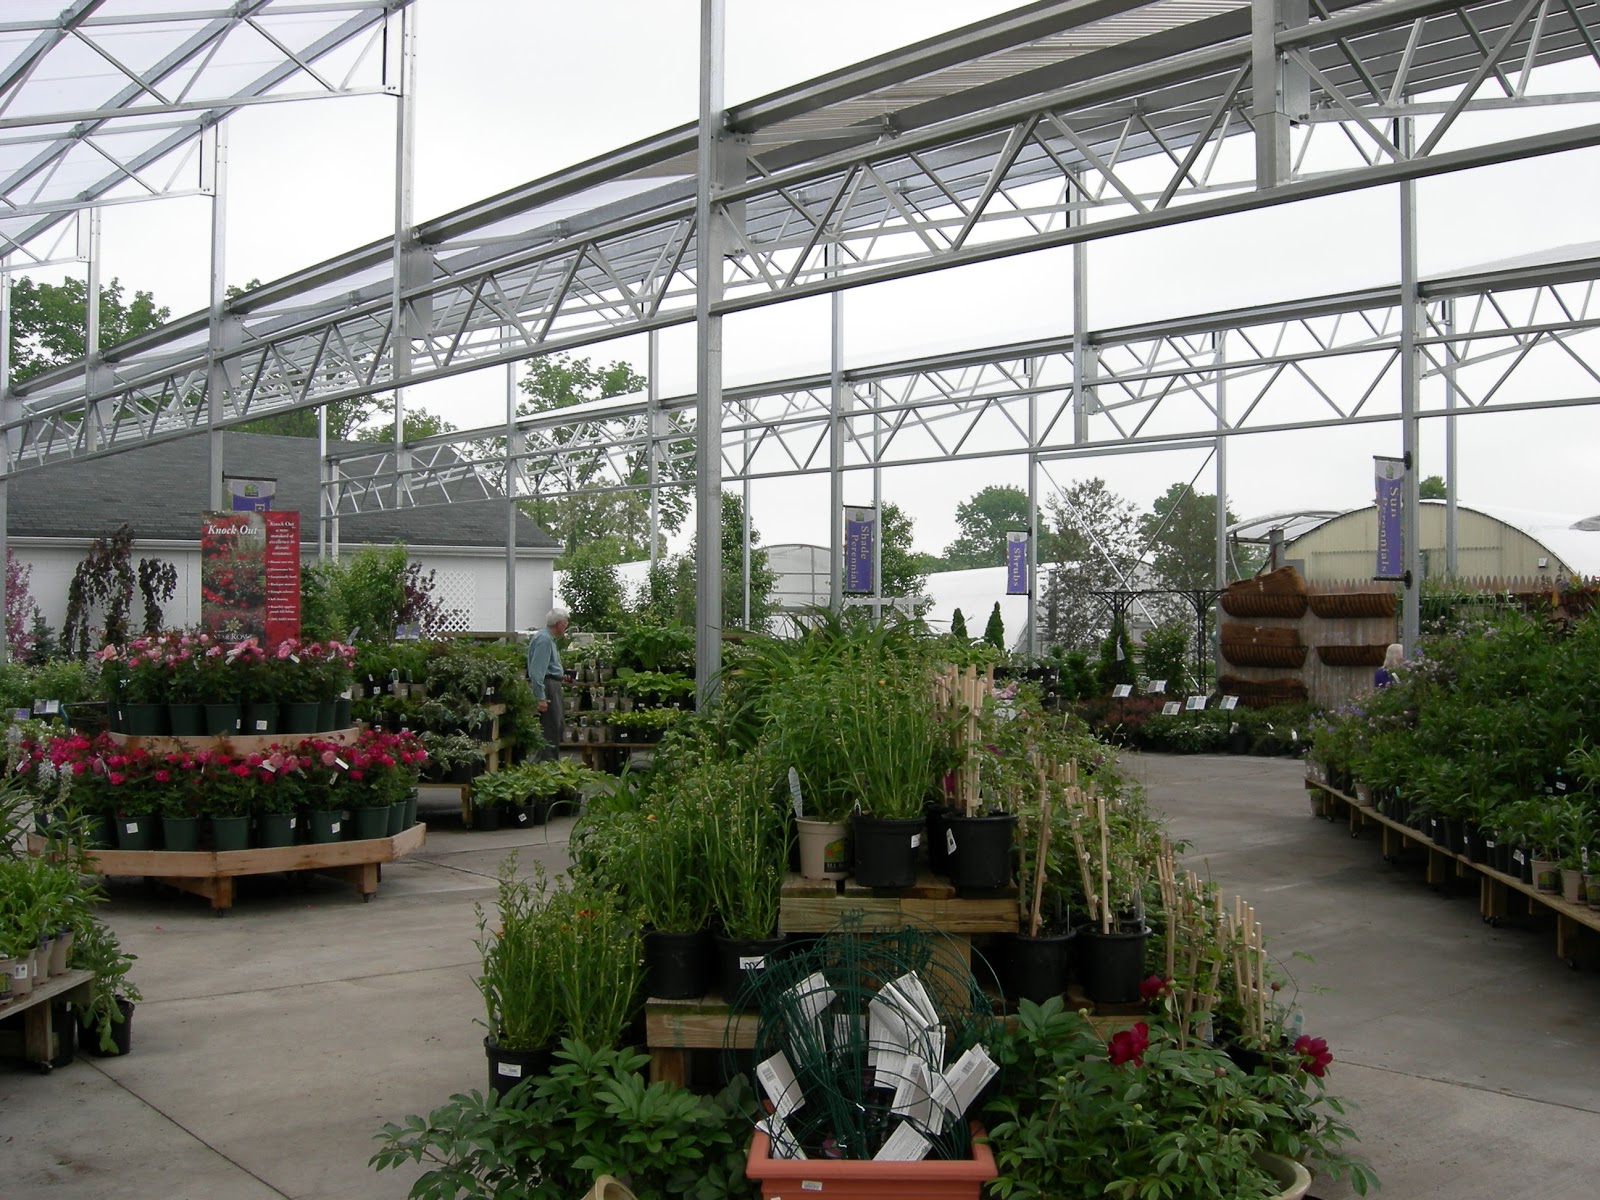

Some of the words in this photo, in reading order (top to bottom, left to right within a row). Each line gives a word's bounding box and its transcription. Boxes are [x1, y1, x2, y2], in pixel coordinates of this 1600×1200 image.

[1390, 487, 1399, 517] Sun
[208, 525, 237, 535] Knock
[239, 524, 258, 535] Out
[861, 525, 869, 560] Shade
[1380, 497, 1390, 572] Perennials
[851, 534, 859, 588] Perennials
[1013, 547, 1021, 587] Shrubs
